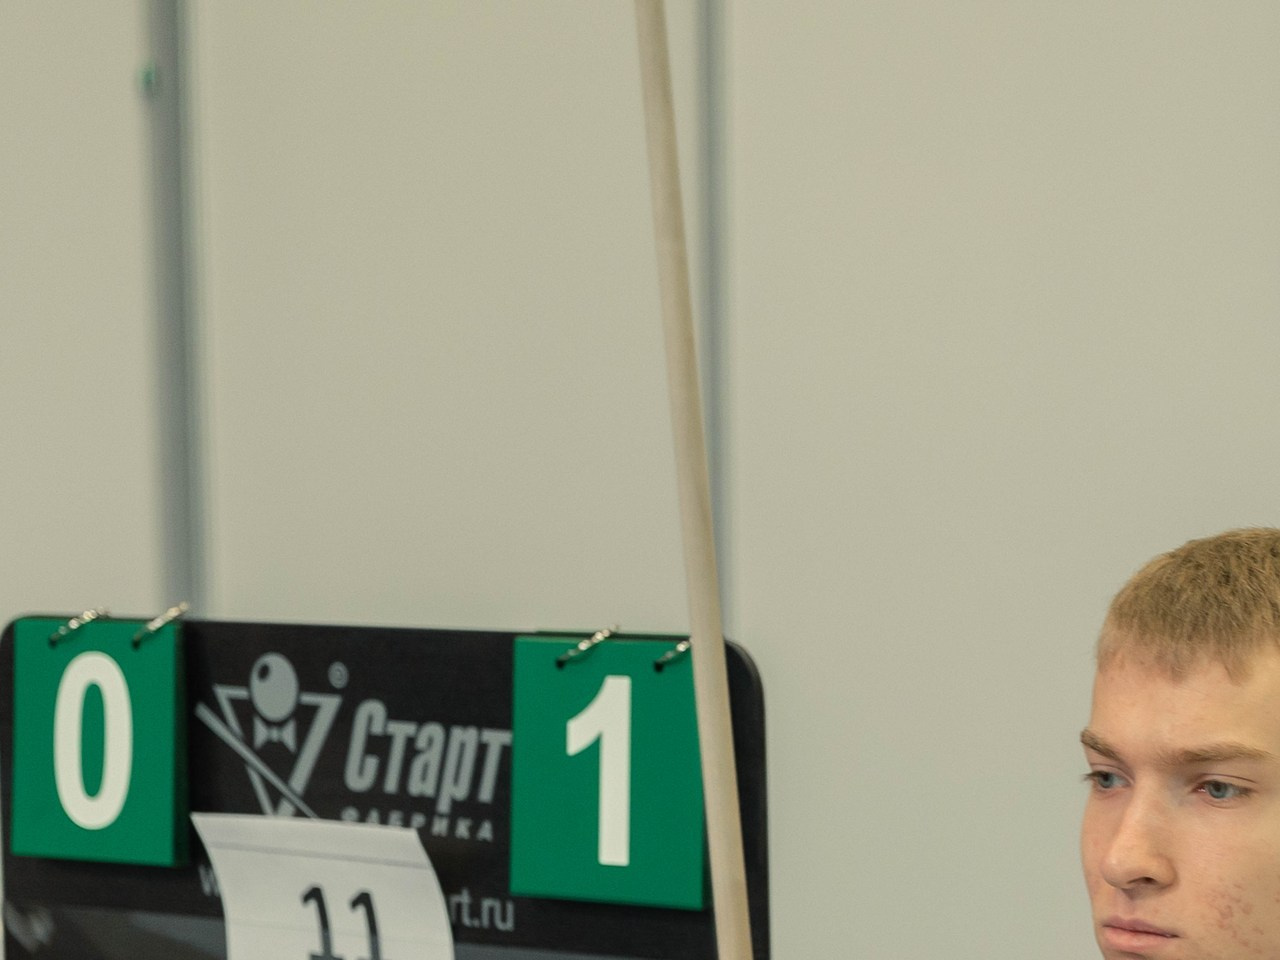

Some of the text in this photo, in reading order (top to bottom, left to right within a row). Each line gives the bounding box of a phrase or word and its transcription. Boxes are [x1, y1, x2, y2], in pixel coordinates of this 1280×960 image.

[53, 650, 133, 830] 0
[345, 699, 513, 806] Старт
[566, 674, 632, 867] 1
